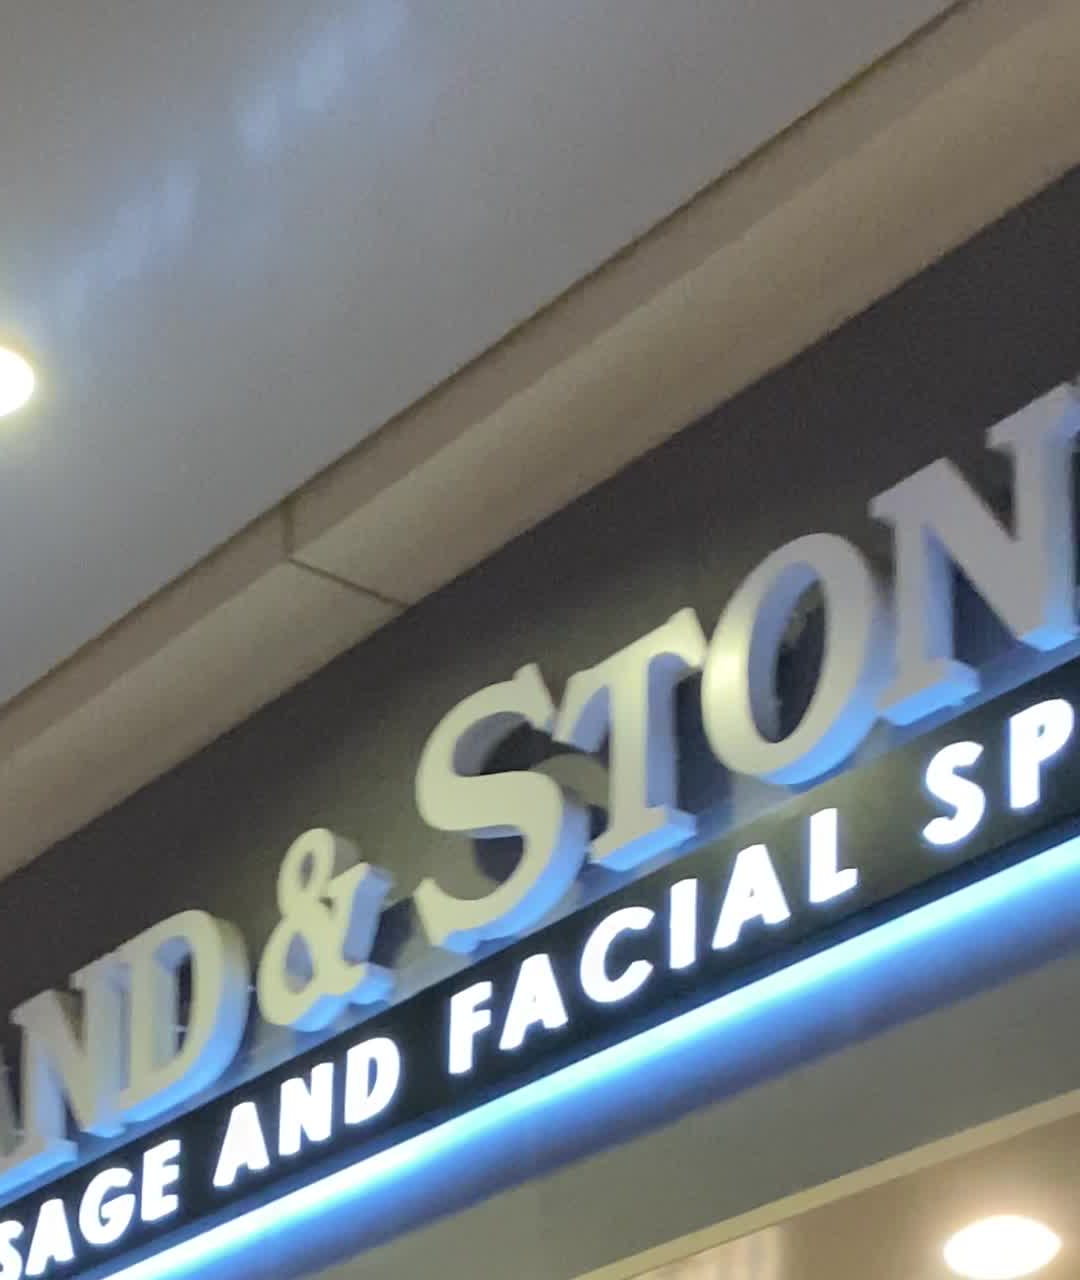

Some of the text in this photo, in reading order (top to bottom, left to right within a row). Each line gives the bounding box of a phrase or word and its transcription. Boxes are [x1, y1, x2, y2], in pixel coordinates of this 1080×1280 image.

[213, 1036, 401, 1188] AND
[447, 807, 859, 1075] FACIAL
[256, 828, 384, 1030] &
